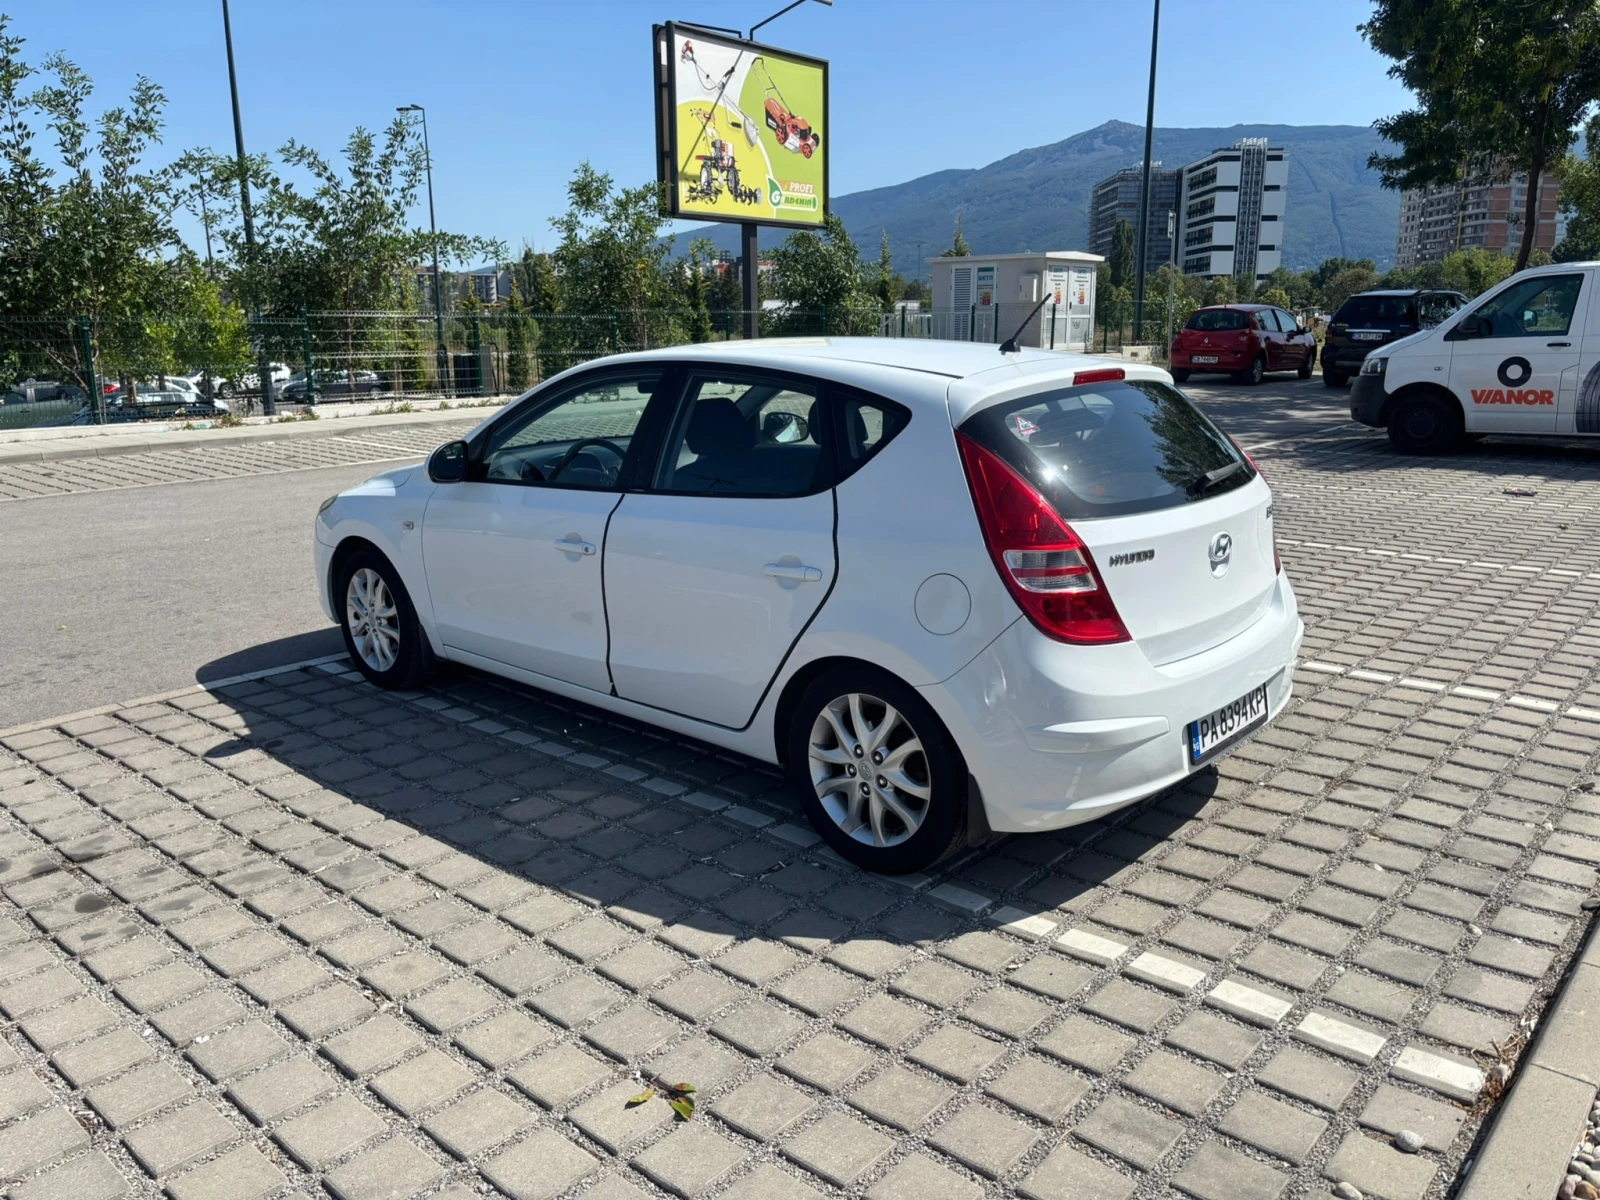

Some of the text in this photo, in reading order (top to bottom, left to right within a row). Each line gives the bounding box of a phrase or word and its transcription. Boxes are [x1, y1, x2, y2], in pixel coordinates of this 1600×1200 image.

[789, 182, 814, 193] PROFI
[1470, 389, 1554, 405] VIANOR
[1109, 548, 1155, 567] HYUNDAI
